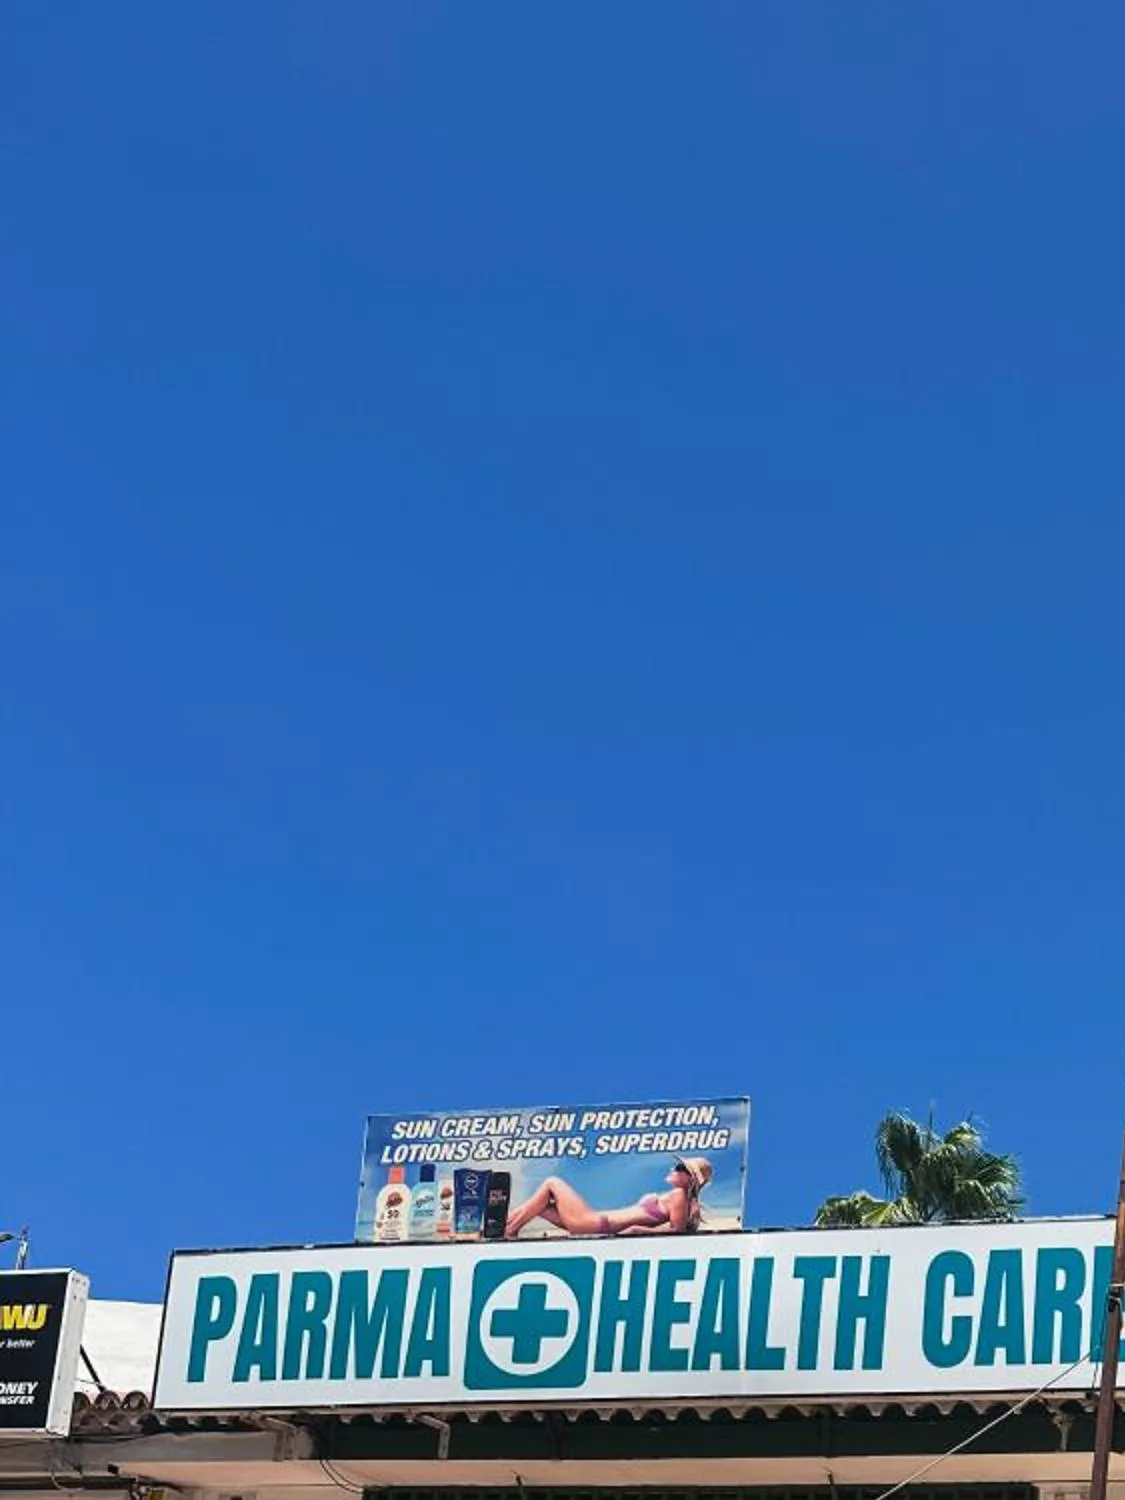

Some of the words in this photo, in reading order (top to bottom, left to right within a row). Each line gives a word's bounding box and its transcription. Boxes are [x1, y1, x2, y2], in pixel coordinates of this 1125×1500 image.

[392, 1118, 437, 1140] SUN
[440, 1113, 524, 1138] CREAM,
[529, 1111, 573, 1133] SUN
[576, 1105, 719, 1131] PROTECTION,
[380, 1140, 468, 1164] LOTIONS
[471, 1139, 491, 1161] &
[497, 1135, 587, 1159] SPRAYS,
[595, 1129, 728, 1153] SUPERDRUG
[187, 1266, 452, 1382] PARMA
[593, 1255, 891, 1373] HEALTH
[0, 1381, 38, 1395] ONEY
